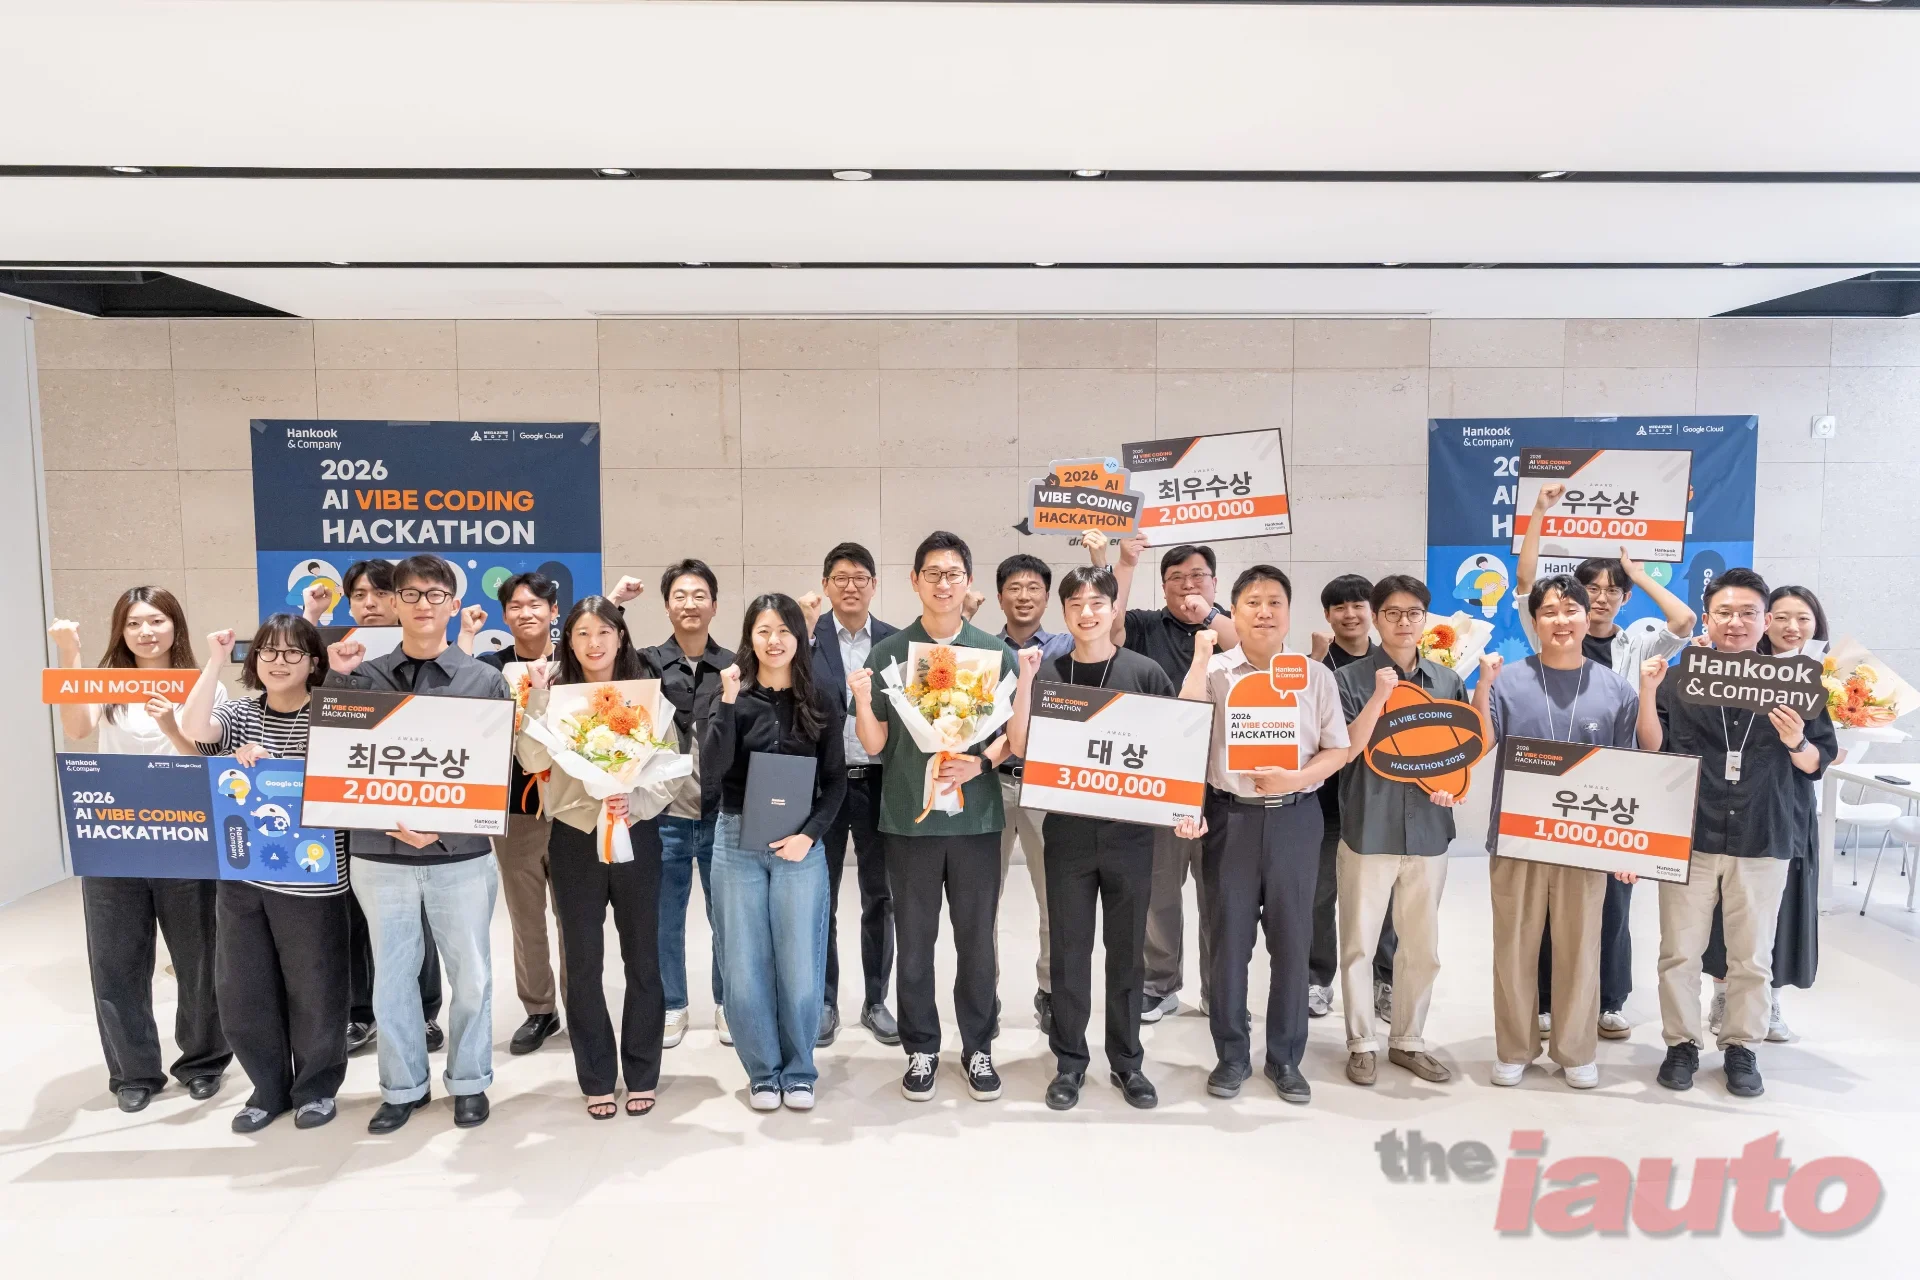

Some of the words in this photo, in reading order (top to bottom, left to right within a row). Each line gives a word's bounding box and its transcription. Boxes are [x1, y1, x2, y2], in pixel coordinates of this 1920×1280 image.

[287, 428, 337, 439] Hankook
[520, 432, 543, 440] Google
[1463, 427, 1511, 436] Hankook
[1683, 426, 1704, 434] Google
[288, 440, 296, 448] &
[297, 440, 341, 450] Company
[1464, 438, 1471, 446] &
[1472, 438, 1514, 447] Company
[320, 459, 388, 481] 2026
[1493, 456, 1520, 476] 20
[1064, 470, 1098, 482] 2026
[1105, 480, 1118, 490] AI
[1158, 471, 1252, 501] 최우수상
[322, 490, 348, 509] AI
[355, 490, 418, 511] VIBE
[425, 490, 534, 511] CODING
[1039, 491, 1071, 503] VIBE
[1077, 493, 1132, 513] CODING
[1562, 490, 1639, 516] 우수상
[1039, 512, 1126, 527] HACKATHON
[1159, 500, 1255, 524] 2,000,000
[323, 519, 535, 545] HACKATHON
[1546, 518, 1648, 537] 1,000,000
[1544, 562, 1576, 573] Hank
[1688, 654, 1813, 684] Hankook
[60, 681, 79, 693] AI
[84, 681, 103, 693] IN
[109, 680, 184, 694] MOTION
[1686, 678, 1704, 696] &
[1709, 681, 1819, 711] Company
[322, 710, 366, 718] HACKATHON
[1042, 702, 1082, 712] HACKATHON
[1390, 719, 1398, 728] AI
[1398, 714, 1417, 724] VIBE
[1418, 712, 1452, 720] CODING
[347, 743, 470, 779] 최우수상
[1390, 761, 1444, 770] HACKATHON
[1445, 752, 1466, 766] 2026
[1515, 758, 1556, 766] HACKATHON
[1057, 767, 1166, 798] 3,000,000
[72, 792, 115, 804] 2026
[342, 780, 466, 806] 2,000,000
[76, 810, 92, 820] AI
[95, 809, 135, 821] VIBE
[138, 809, 206, 823] CODING
[1552, 790, 1639, 825] 우수상
[76, 824, 209, 841] HACKATHON
[1534, 820, 1648, 850] 1,000,000
[236, 827, 245, 857] Hankook
